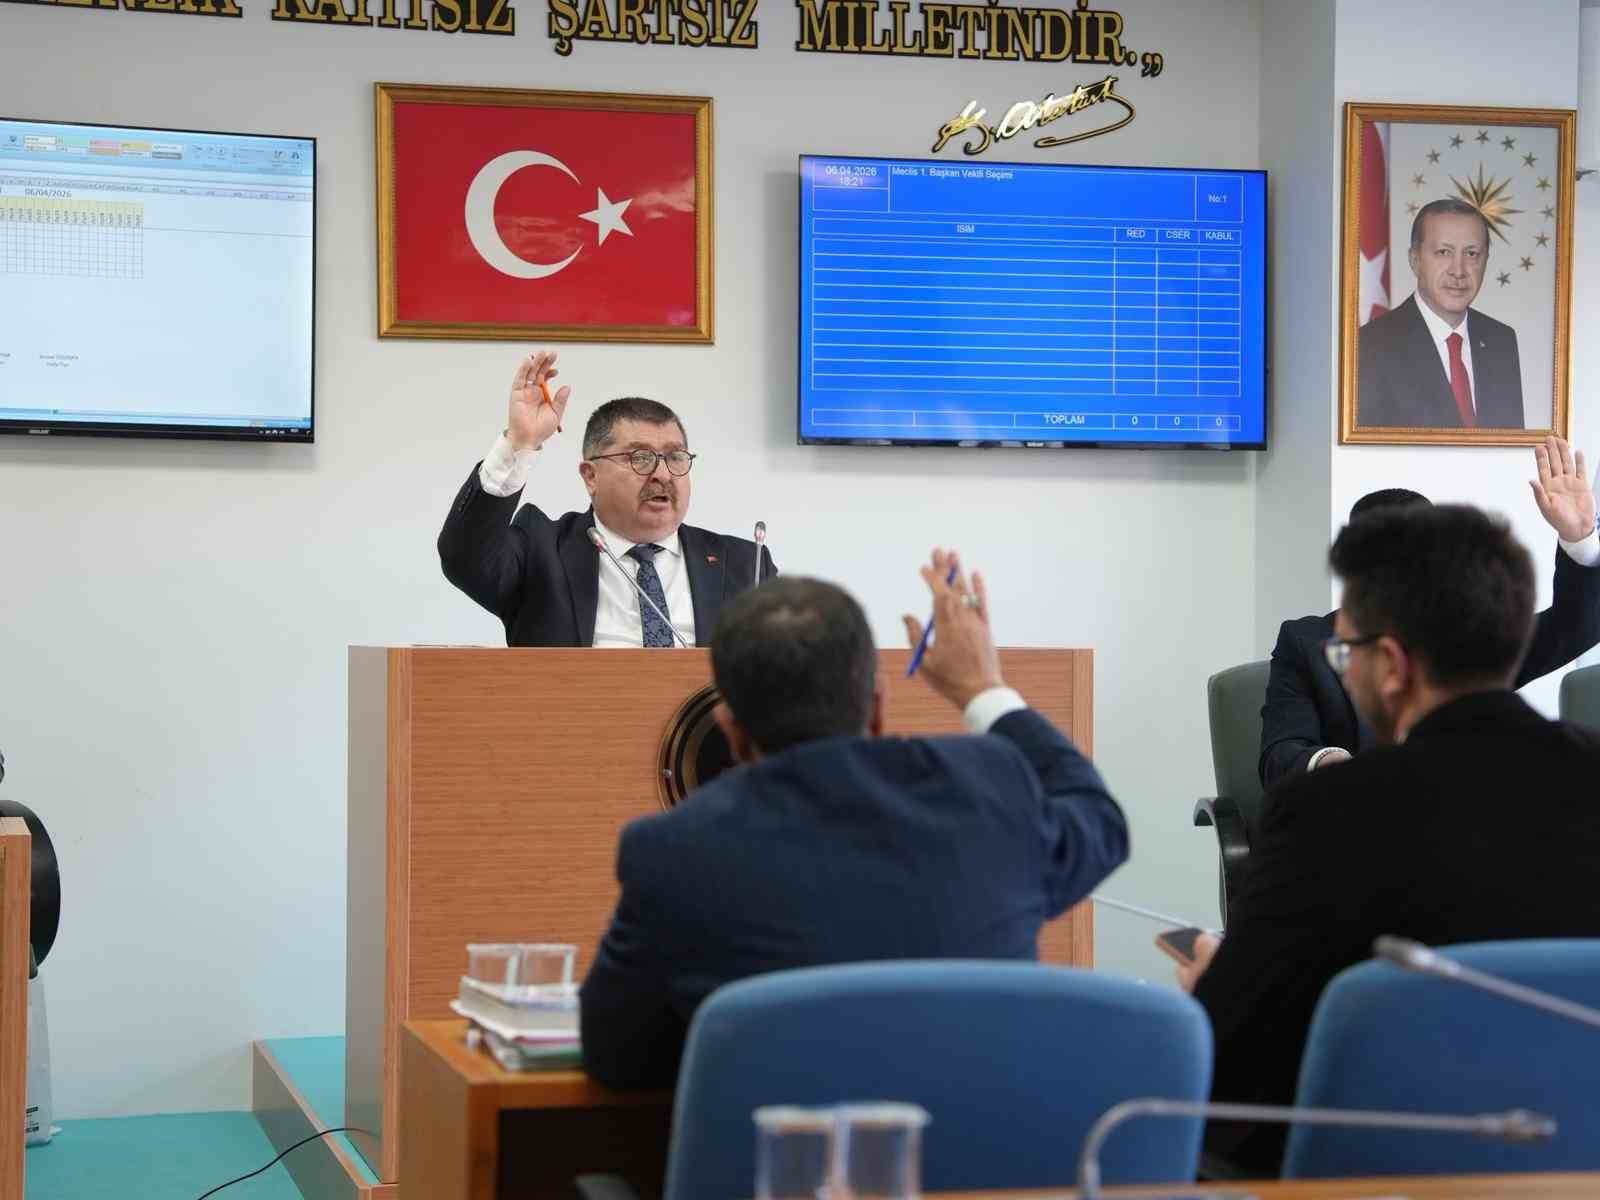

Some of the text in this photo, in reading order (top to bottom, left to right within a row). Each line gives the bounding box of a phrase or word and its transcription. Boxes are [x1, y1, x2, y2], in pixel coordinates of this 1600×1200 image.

[548, 0, 758, 56] ŞARTSIZ
[892, 166, 918, 176] Meclis
[929, 168, 960, 179] Başkan
[1126, 228, 1146, 239] RED
[1205, 231, 1234, 241] KABUL
[1043, 414, 1086, 426] TOPLAM
[1131, 415, 1223, 427] 0 0 0
